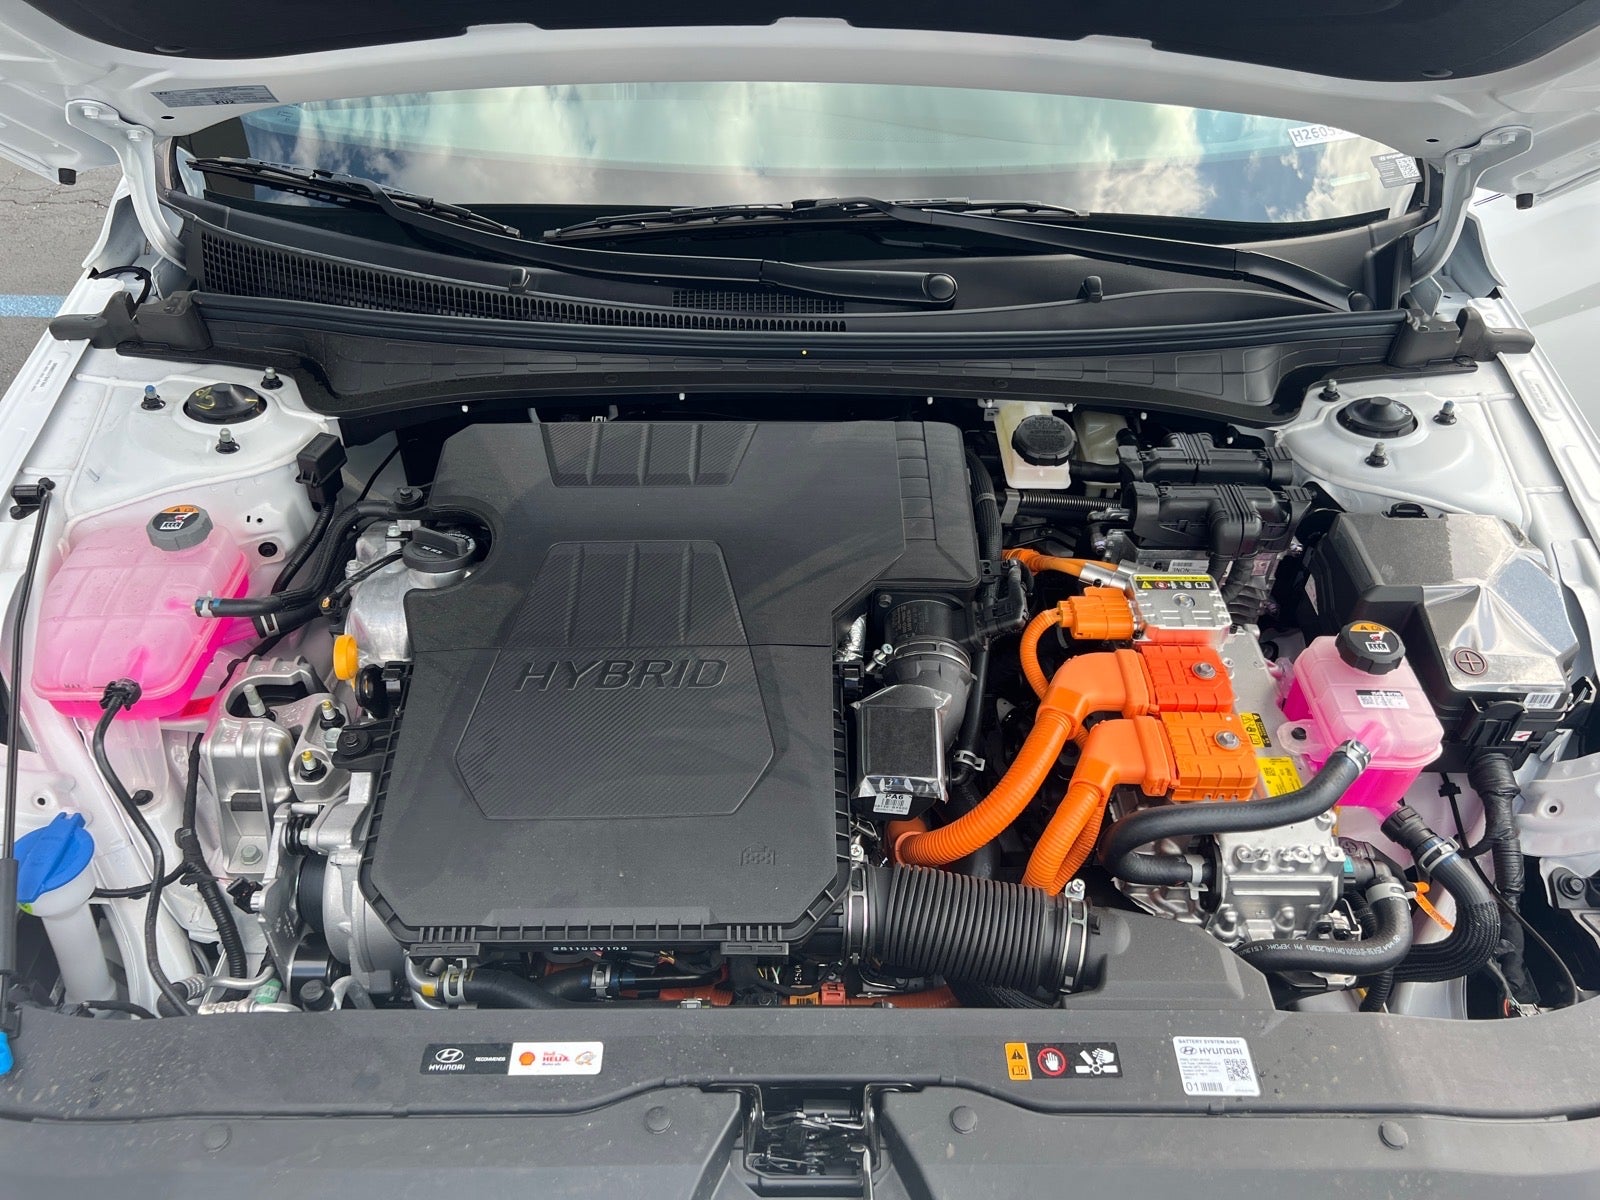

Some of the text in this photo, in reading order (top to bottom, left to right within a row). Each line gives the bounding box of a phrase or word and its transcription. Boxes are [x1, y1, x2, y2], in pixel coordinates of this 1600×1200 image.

[513, 659, 729, 692] HYBRID
[1199, 1047, 1243, 1055] HYUNDAI
[428, 1063, 466, 1071] HYUNDAI
[1185, 1081, 1199, 1092] 01
